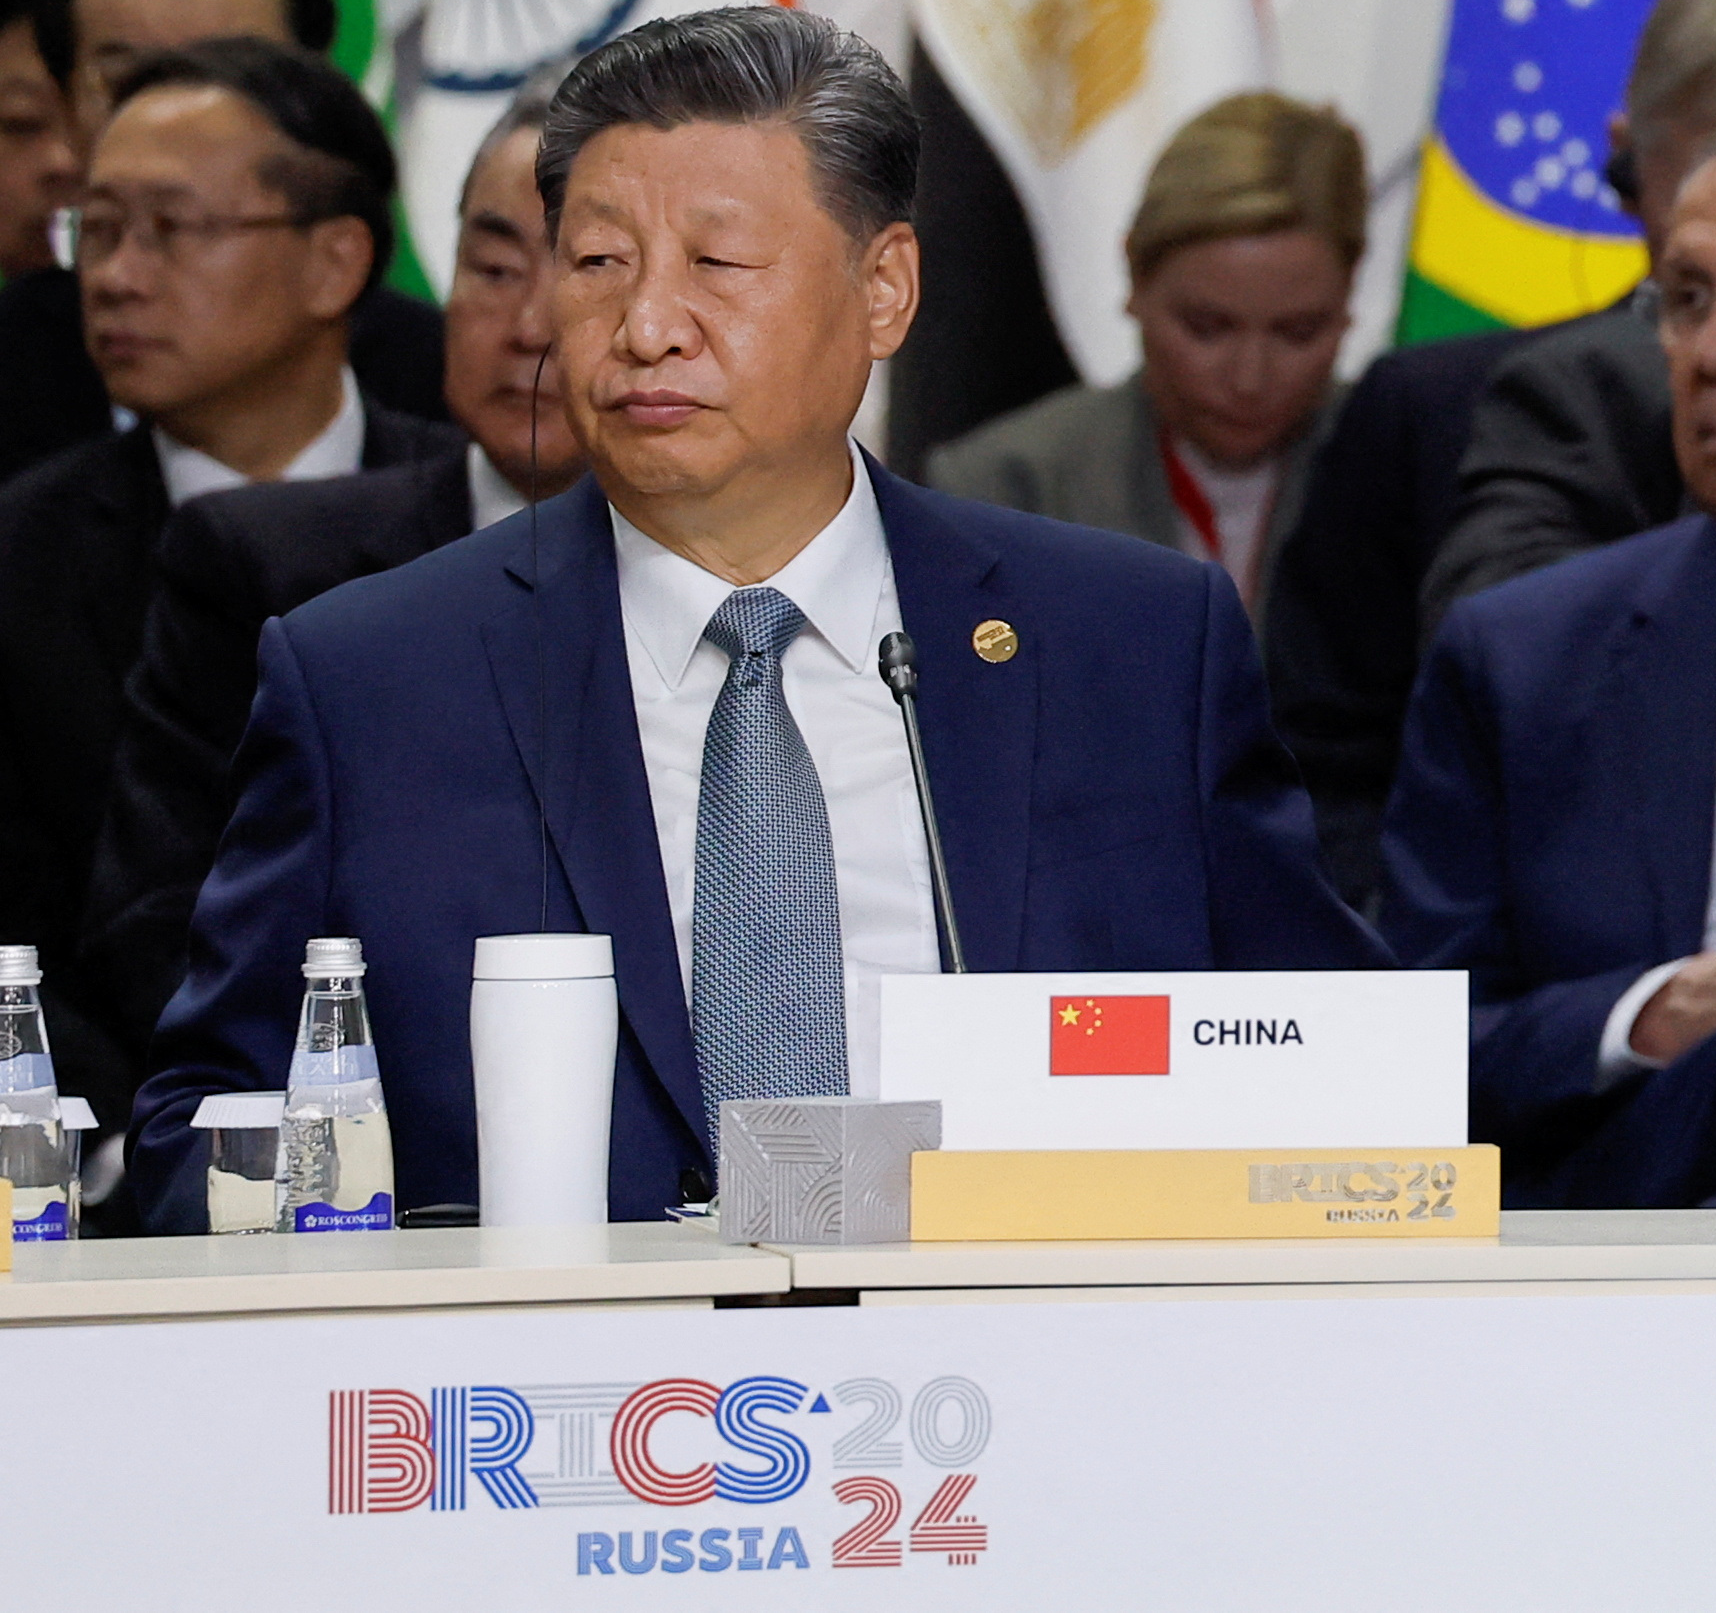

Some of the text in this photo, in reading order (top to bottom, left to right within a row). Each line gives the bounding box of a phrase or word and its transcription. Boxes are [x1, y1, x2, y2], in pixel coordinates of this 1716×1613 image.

[1193, 1019, 1304, 1046] CHINA
[1248, 1161, 1457, 1204] BRICS 20
[1406, 1192, 1457, 1222] 24
[329, 1375, 992, 1515] BRICS 20
[576, 1473, 988, 1576] RUSSIA 24
